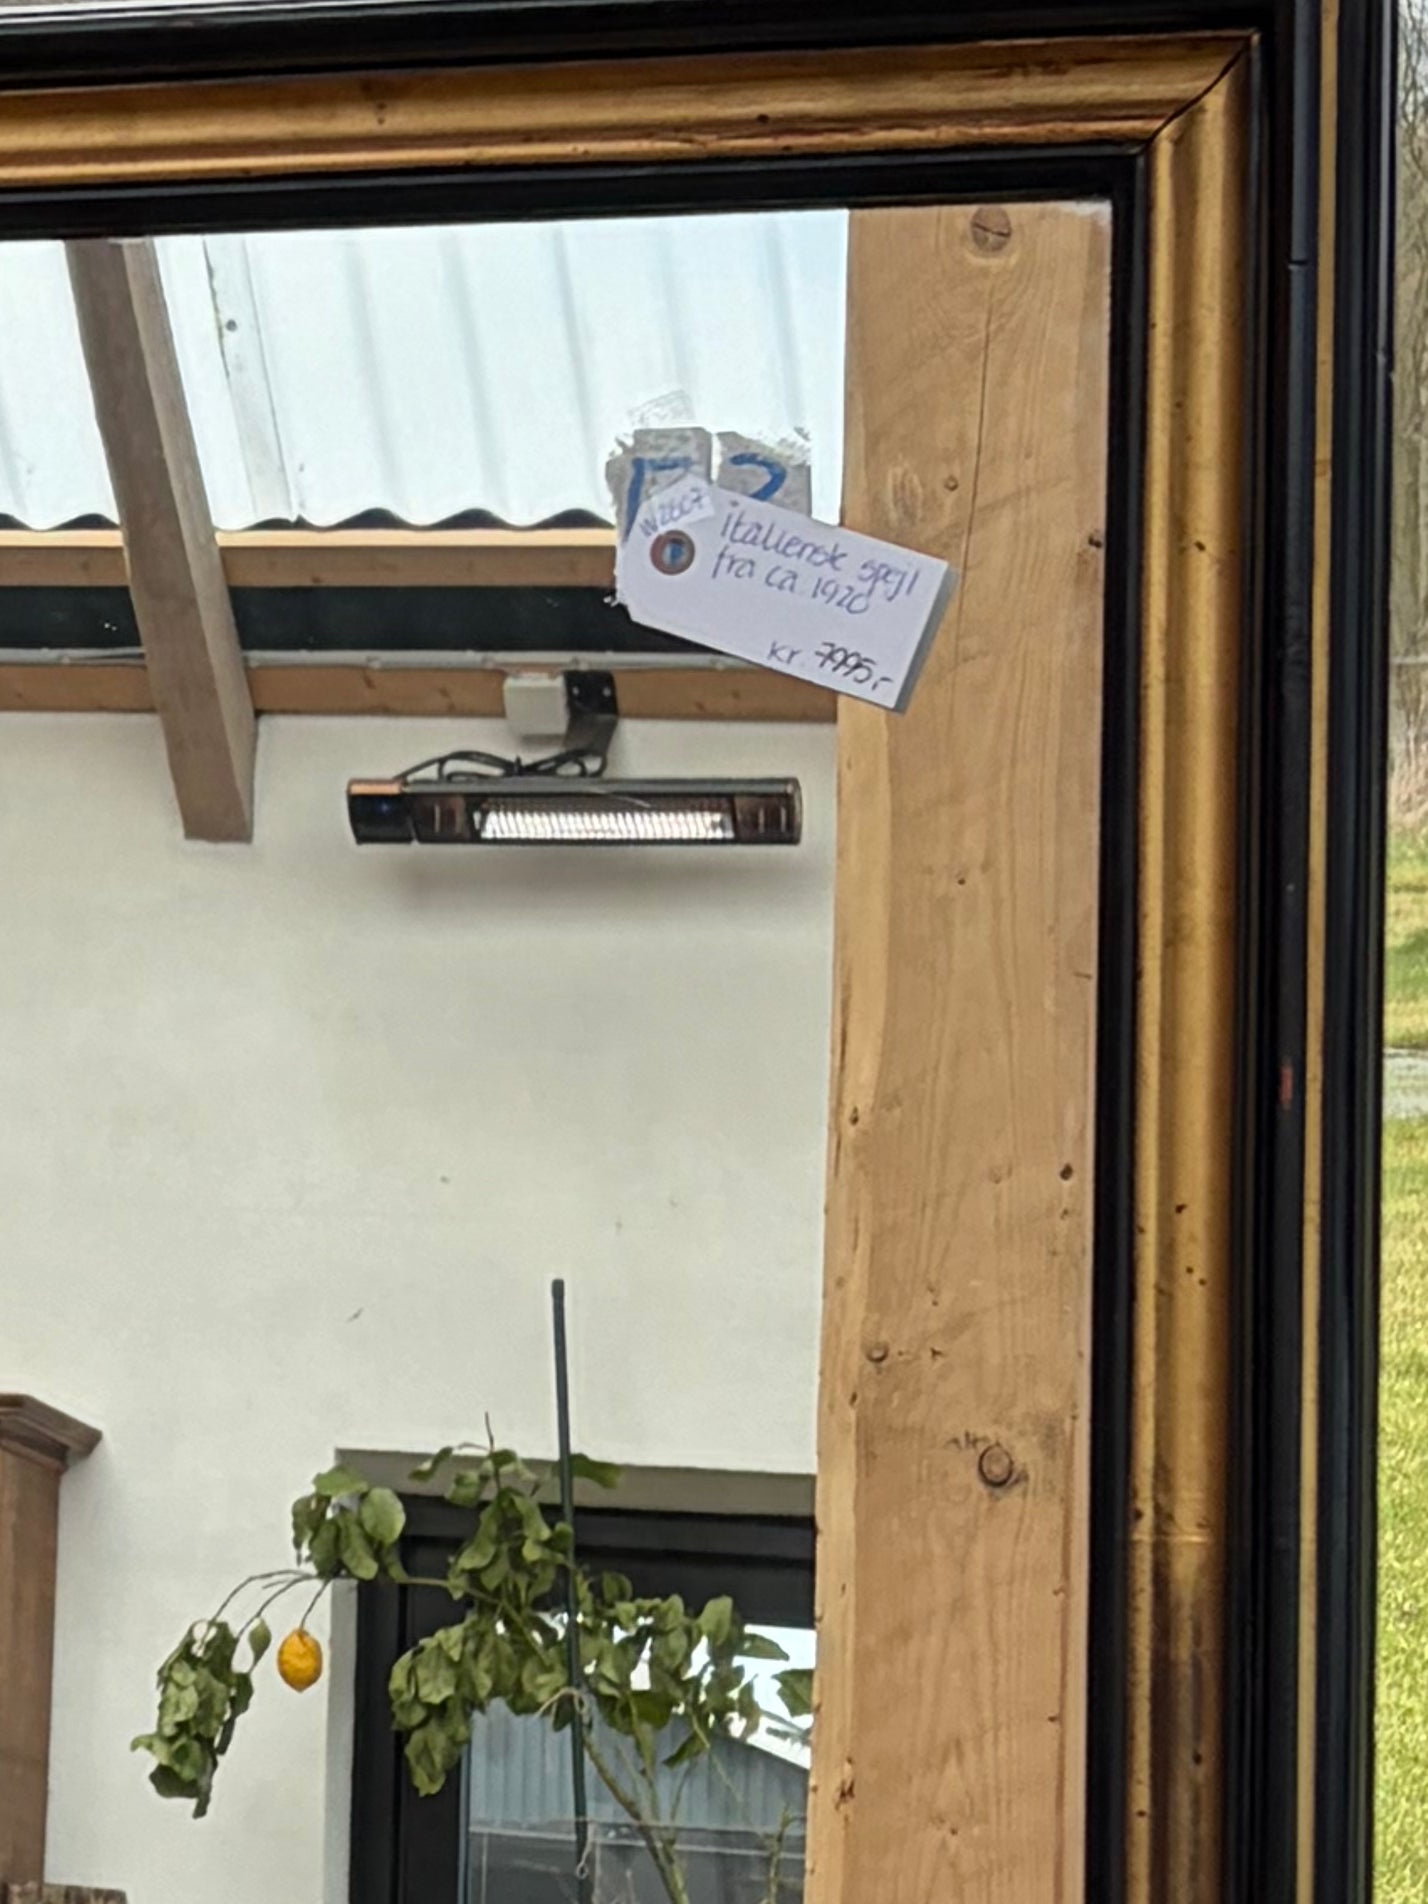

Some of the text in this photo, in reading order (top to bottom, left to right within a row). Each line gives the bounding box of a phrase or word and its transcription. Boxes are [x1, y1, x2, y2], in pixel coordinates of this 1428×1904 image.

[711, 543, 871, 615] fra ca 1920
[857, 559, 920, 602] spejl
